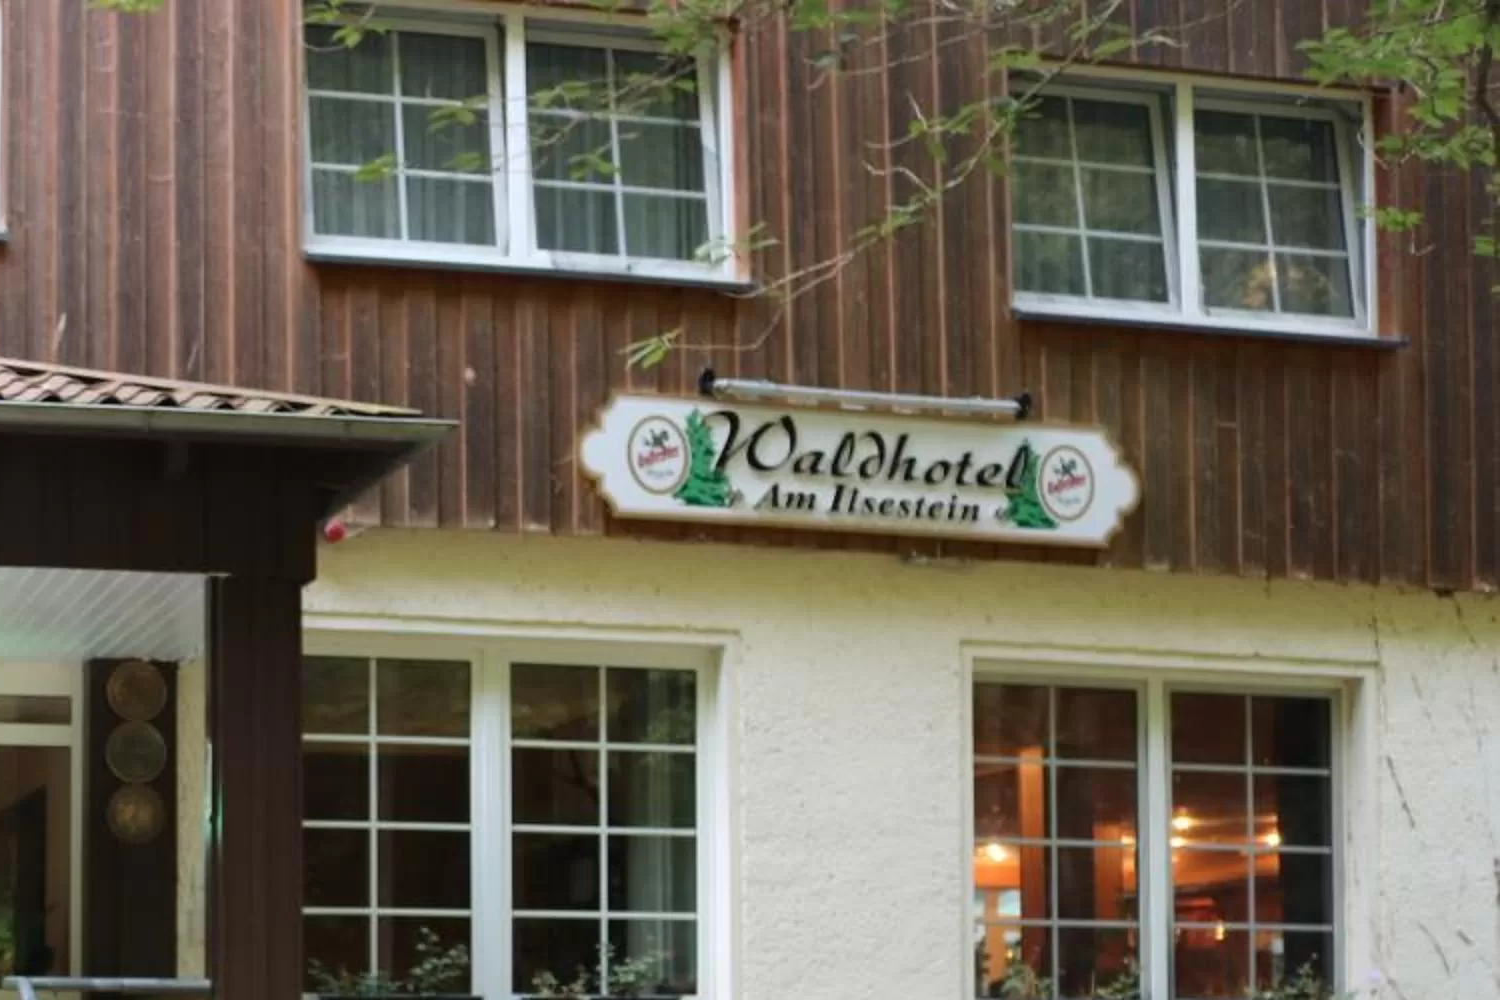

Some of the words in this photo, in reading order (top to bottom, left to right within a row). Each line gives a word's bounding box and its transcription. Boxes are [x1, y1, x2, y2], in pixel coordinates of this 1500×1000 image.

[703, 409, 1030, 490] Waldhotel
[754, 482, 816, 511] Am
[829, 483, 980, 520] Ilsestein
